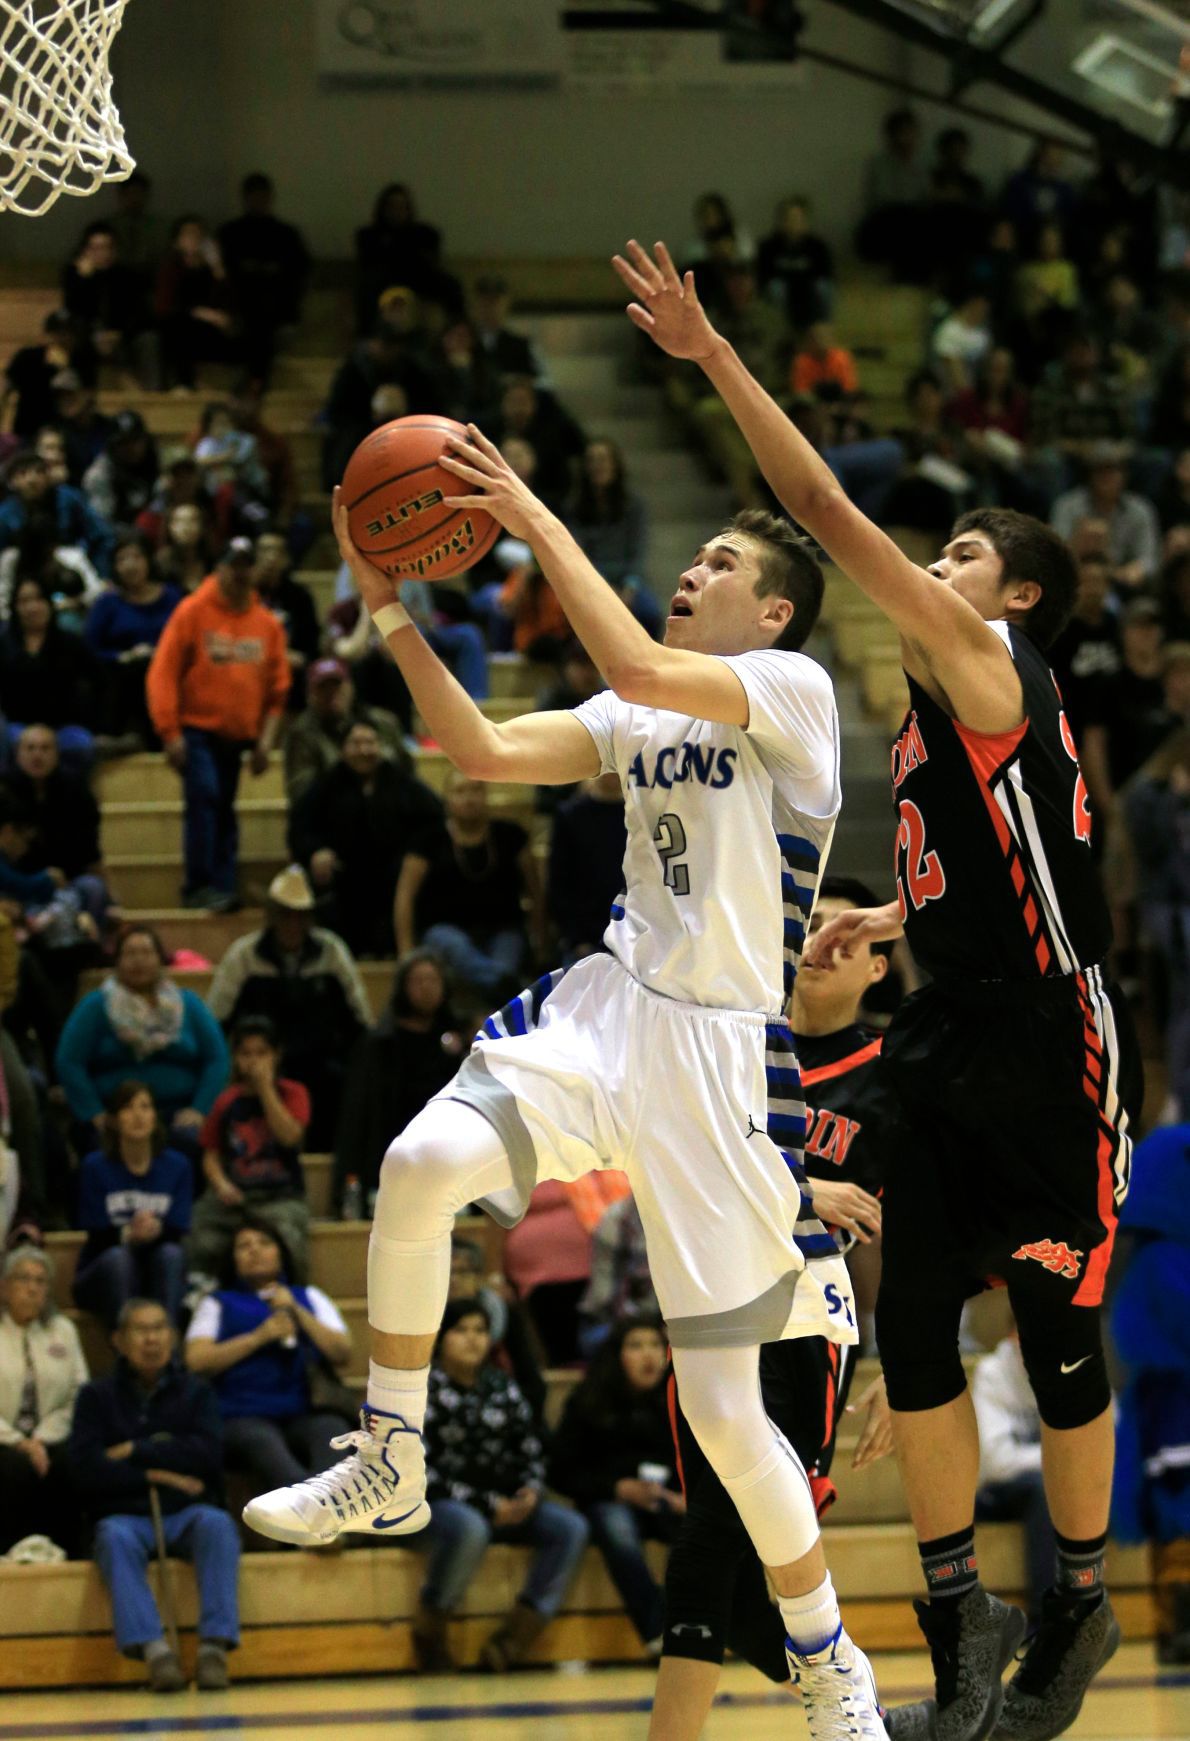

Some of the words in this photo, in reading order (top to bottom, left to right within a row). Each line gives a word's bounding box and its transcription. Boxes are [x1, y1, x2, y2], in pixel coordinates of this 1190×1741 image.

[366, 488, 443, 537] ELITE
[386, 517, 474, 576] Baden
[627, 741, 738, 790] ACONS
[653, 812, 690, 896] 2
[805, 1106, 861, 1166] IN
